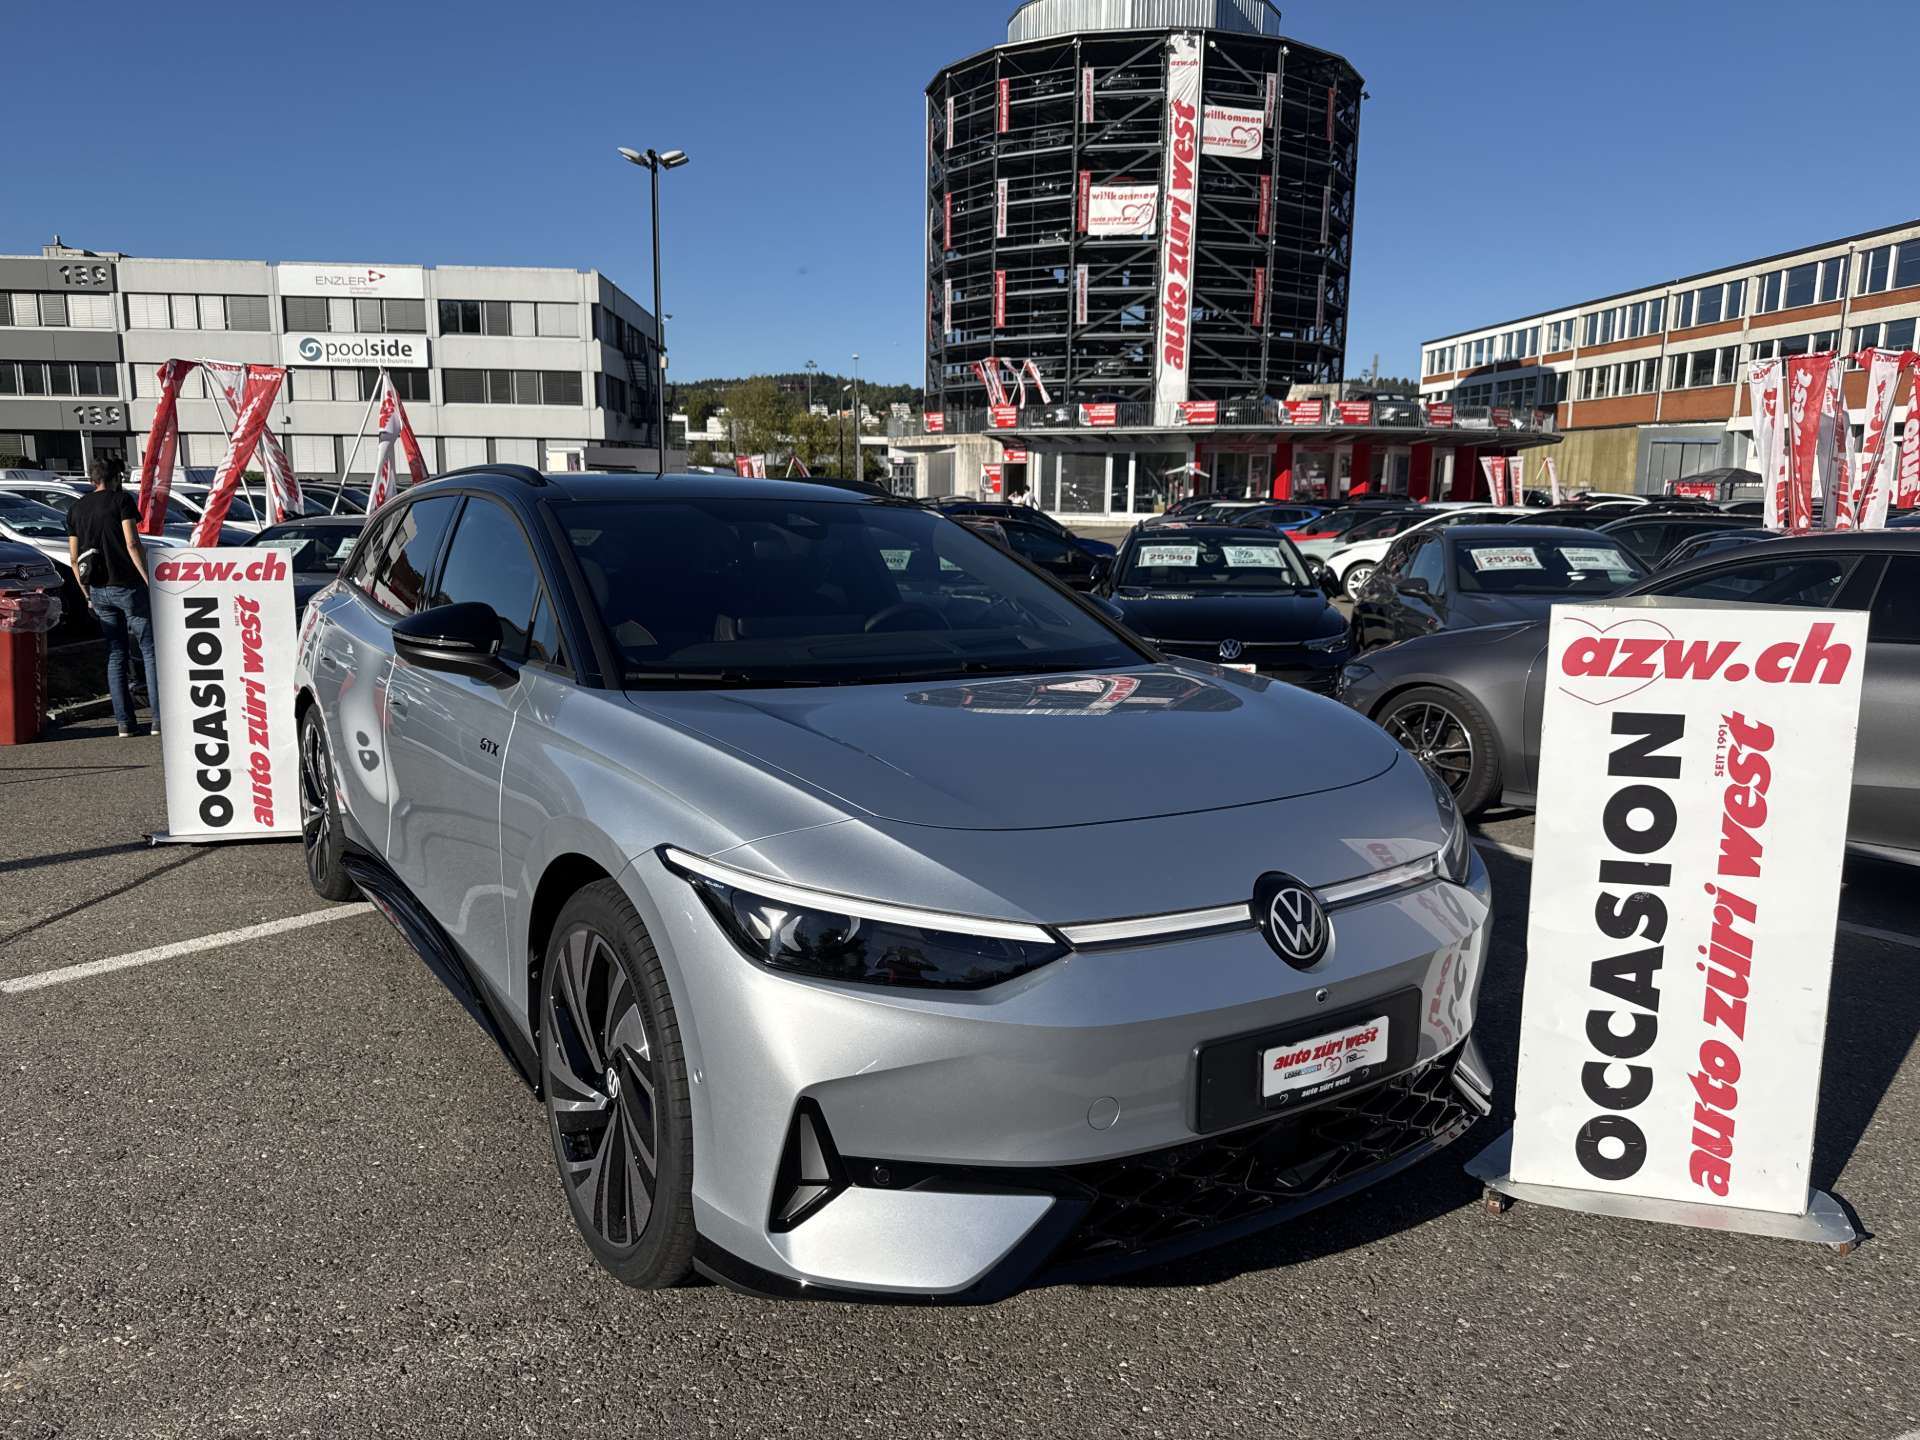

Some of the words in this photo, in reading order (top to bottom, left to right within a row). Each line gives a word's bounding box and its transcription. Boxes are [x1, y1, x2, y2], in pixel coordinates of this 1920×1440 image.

[1170, 58, 1198, 67] azw.ch
[1203, 110, 1261, 123] willkommen
[1172, 99, 1195, 189] west
[1164, 193, 1192, 281] züri
[59, 265, 107, 286] 139
[315, 275, 367, 286] ENZLER
[326, 338, 413, 362] poolside
[1164, 282, 1187, 370] auto
[73, 406, 120, 425] 139
[155, 552, 286, 582] azw.ch
[234, 594, 264, 673] west
[1561, 622, 1852, 685] azw.ch
[183, 597, 234, 828] OCCASION
[239, 676, 270, 750] züri
[1717, 724, 1727, 749] 1991
[480, 738, 499, 757] GTX
[1715, 754, 1725, 777] SEIT
[247, 751, 274, 828] auto
[1717, 710, 1775, 877] west
[1575, 711, 1686, 1181] OCCASION
[1696, 882, 1758, 1041] züri
[1273, 1049, 1311, 1070] auto
[1312, 1036, 1344, 1060] züri
[1345, 1026, 1379, 1049] west
[1301, 1087, 1318, 1098] auto
[1335, 1076, 1351, 1088] west
[1686, 1039, 1741, 1197] auto
